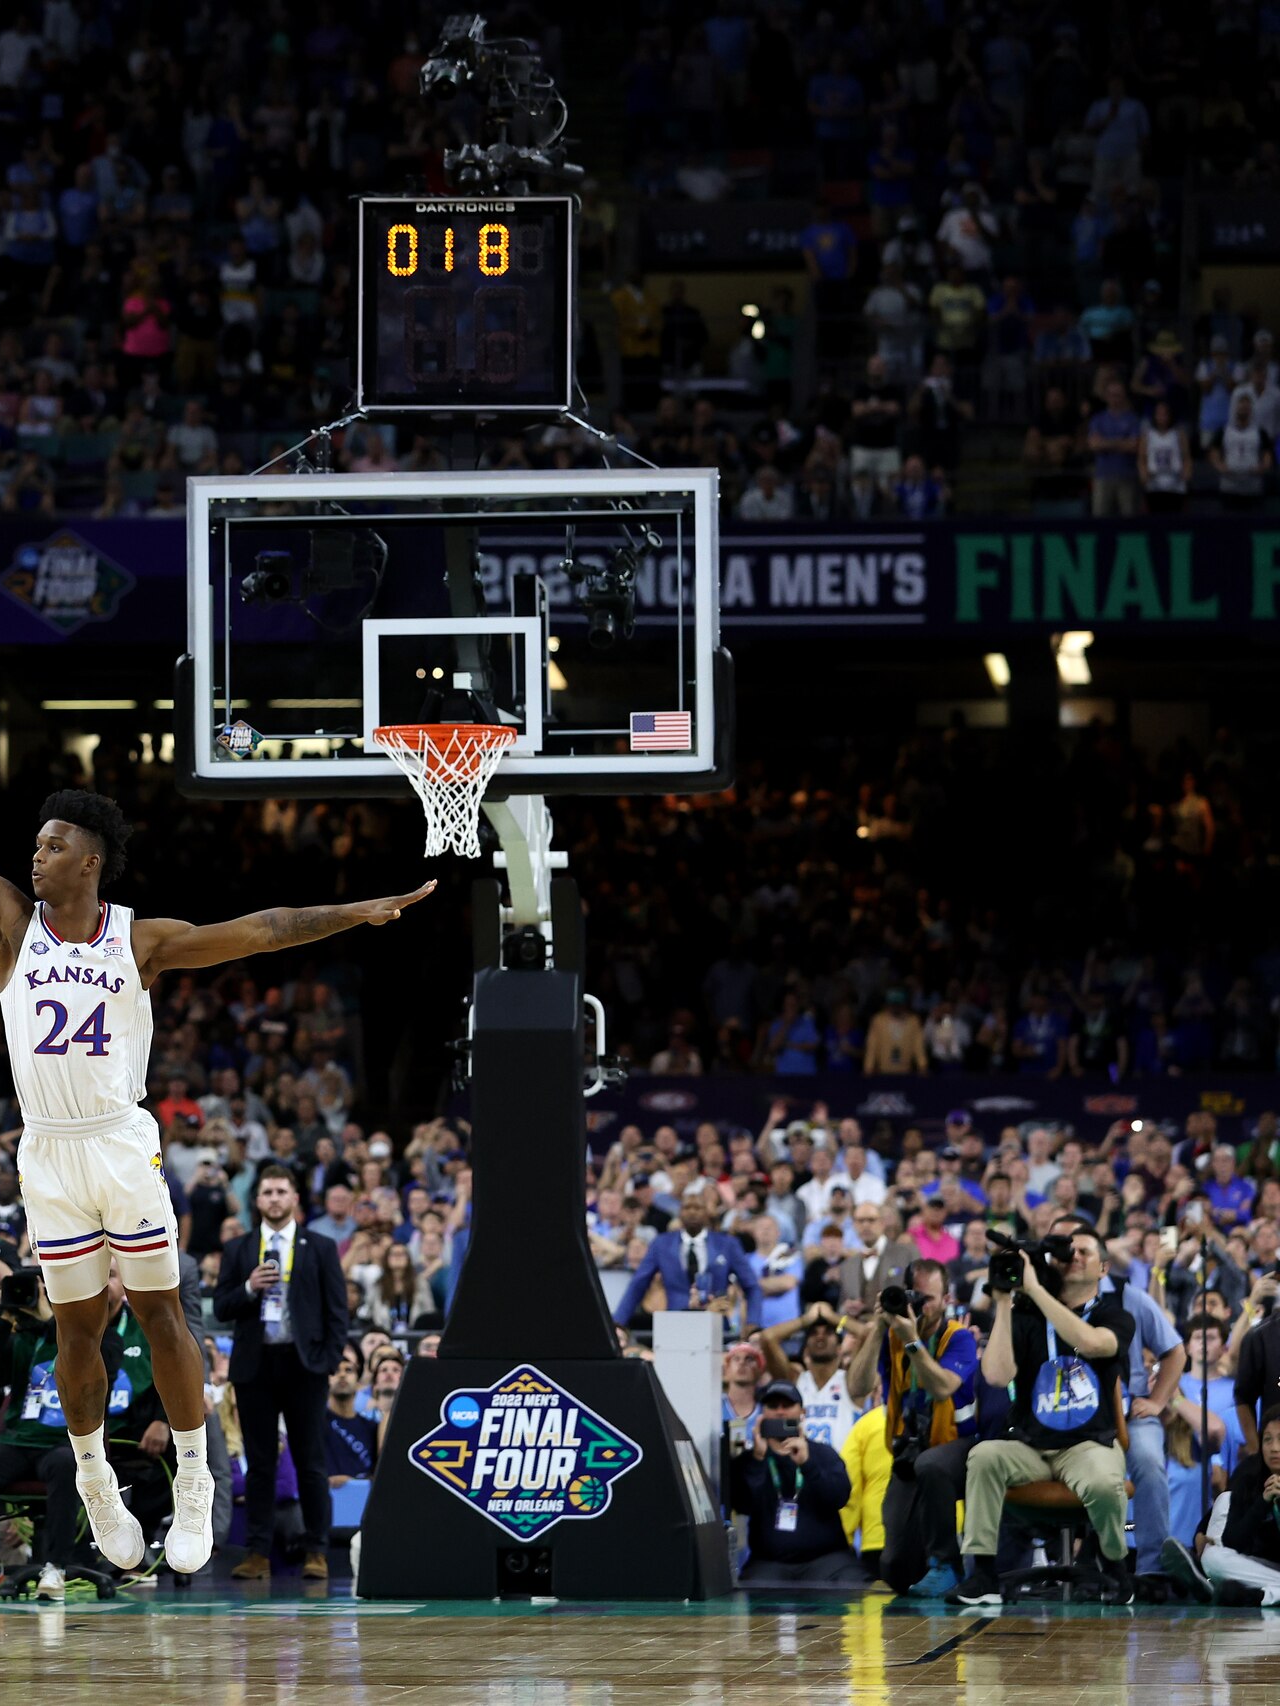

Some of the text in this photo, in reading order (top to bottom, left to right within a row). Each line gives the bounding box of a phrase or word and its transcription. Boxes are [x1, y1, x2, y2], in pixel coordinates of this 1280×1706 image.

[416, 203, 516, 213] DAKTRONICS
[632, 555, 756, 607] NCA
[769, 554, 927, 607] MEN'S
[954, 532, 1220, 622] FINAL
[24, 965, 125, 994] KANSAS
[33, 999, 111, 1057] 24
[135, 1222, 153, 1230] adidas
[491, 1394, 561, 1407] 2022 MEN'S
[450, 1411, 480, 1421] NCAA
[478, 1408, 582, 1447] FINAL
[471, 1449, 578, 1491] FOUR
[487, 1500, 564, 1512] NEW ORLEANS
